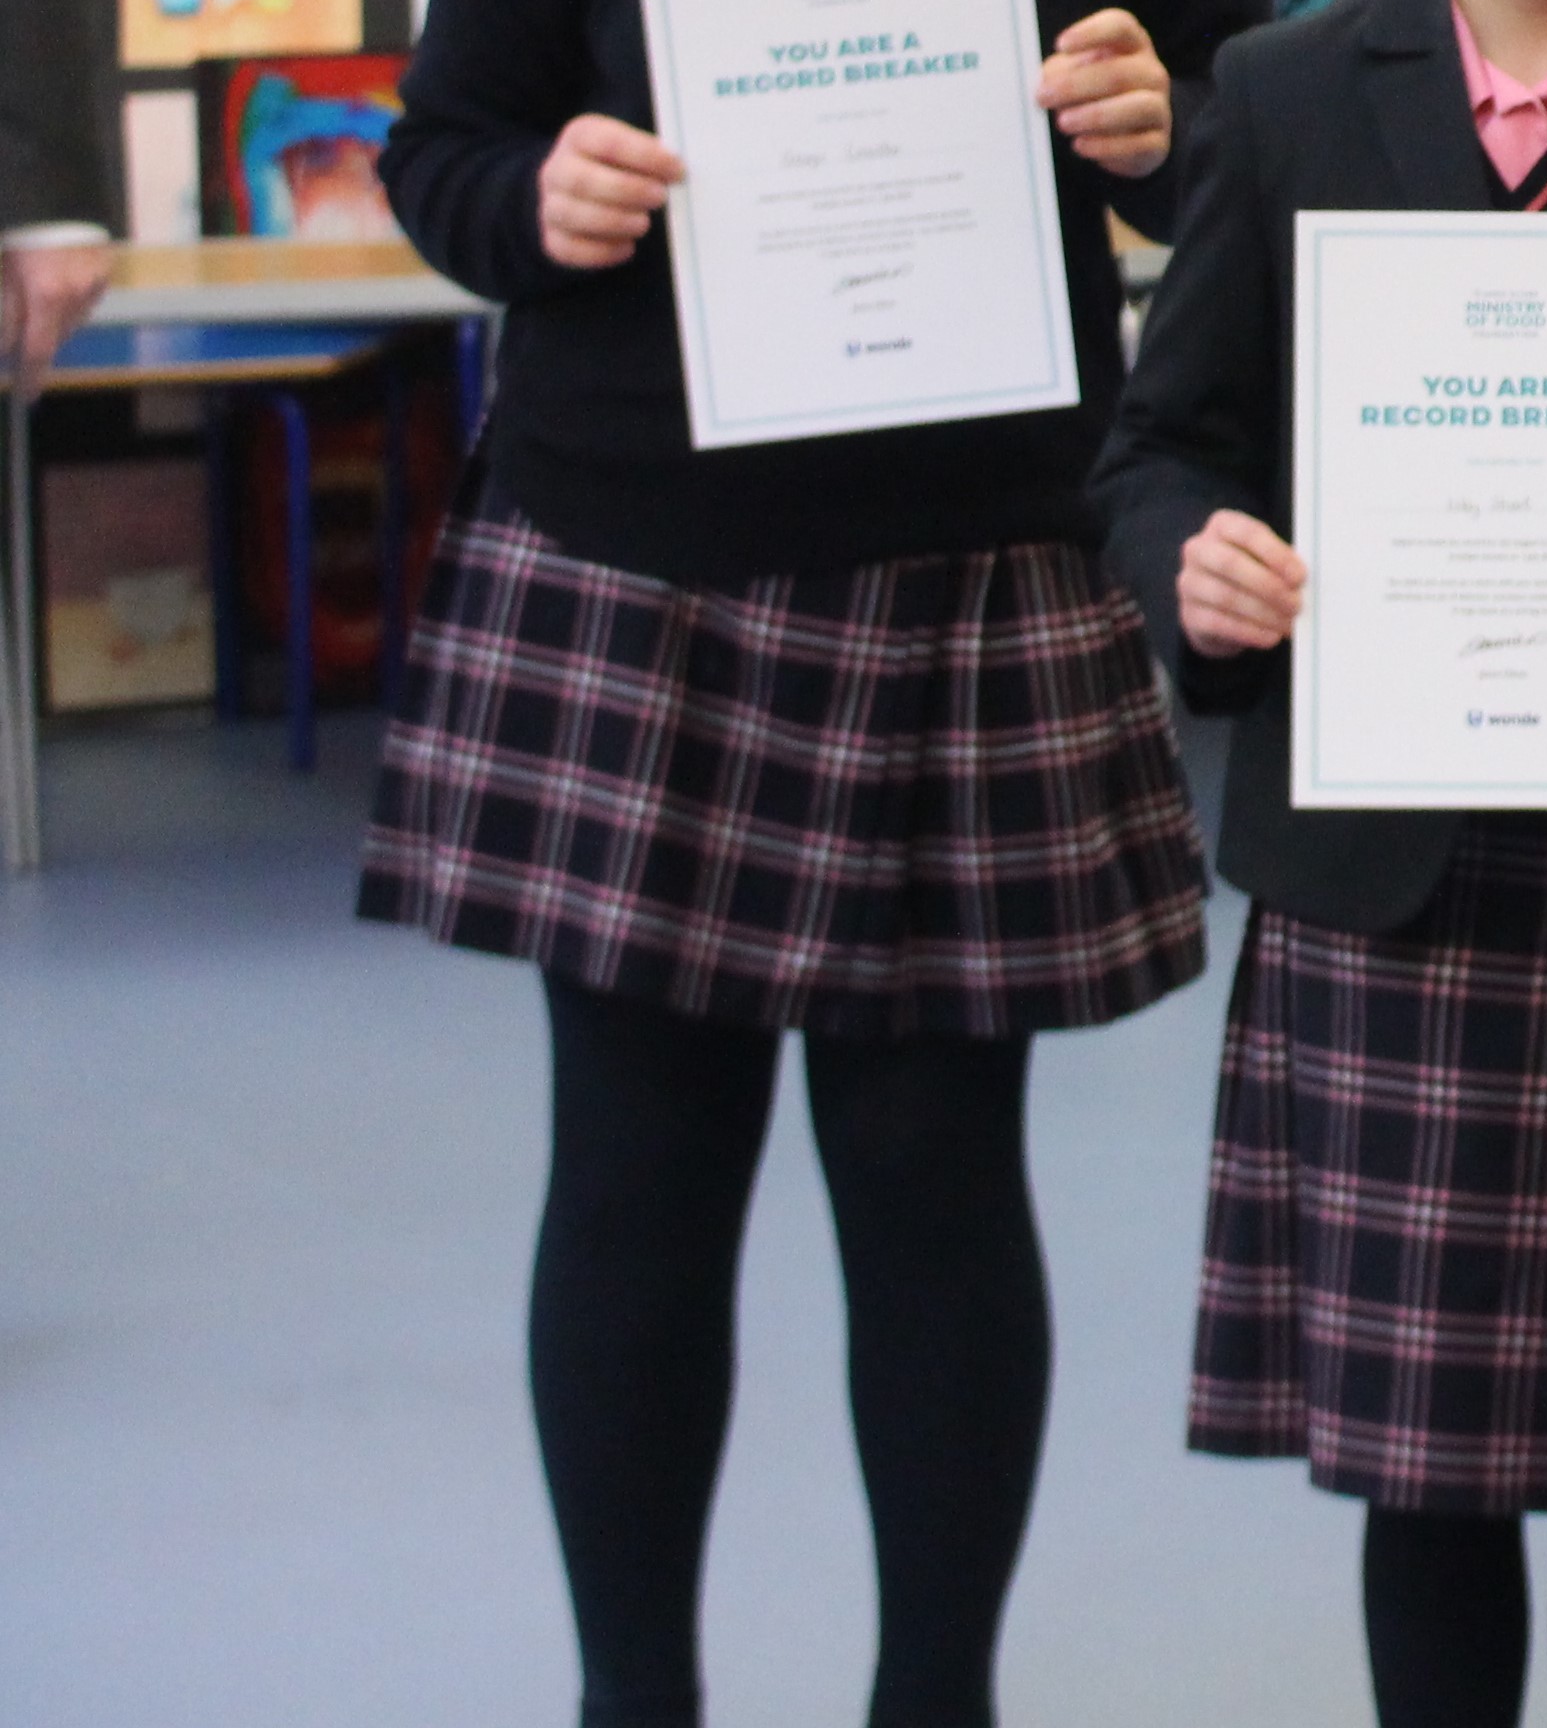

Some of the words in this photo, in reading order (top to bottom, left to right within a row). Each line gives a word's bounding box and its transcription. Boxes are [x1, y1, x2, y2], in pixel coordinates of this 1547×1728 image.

[768, 42, 829, 63] YOU
[837, 34, 892, 57] ARE
[903, 32, 920, 50] A
[714, 67, 836, 97] RECORD
[843, 52, 979, 83] BREAKER
[1423, 376, 1488, 397] YOU
[1360, 405, 1492, 427] RECORD
